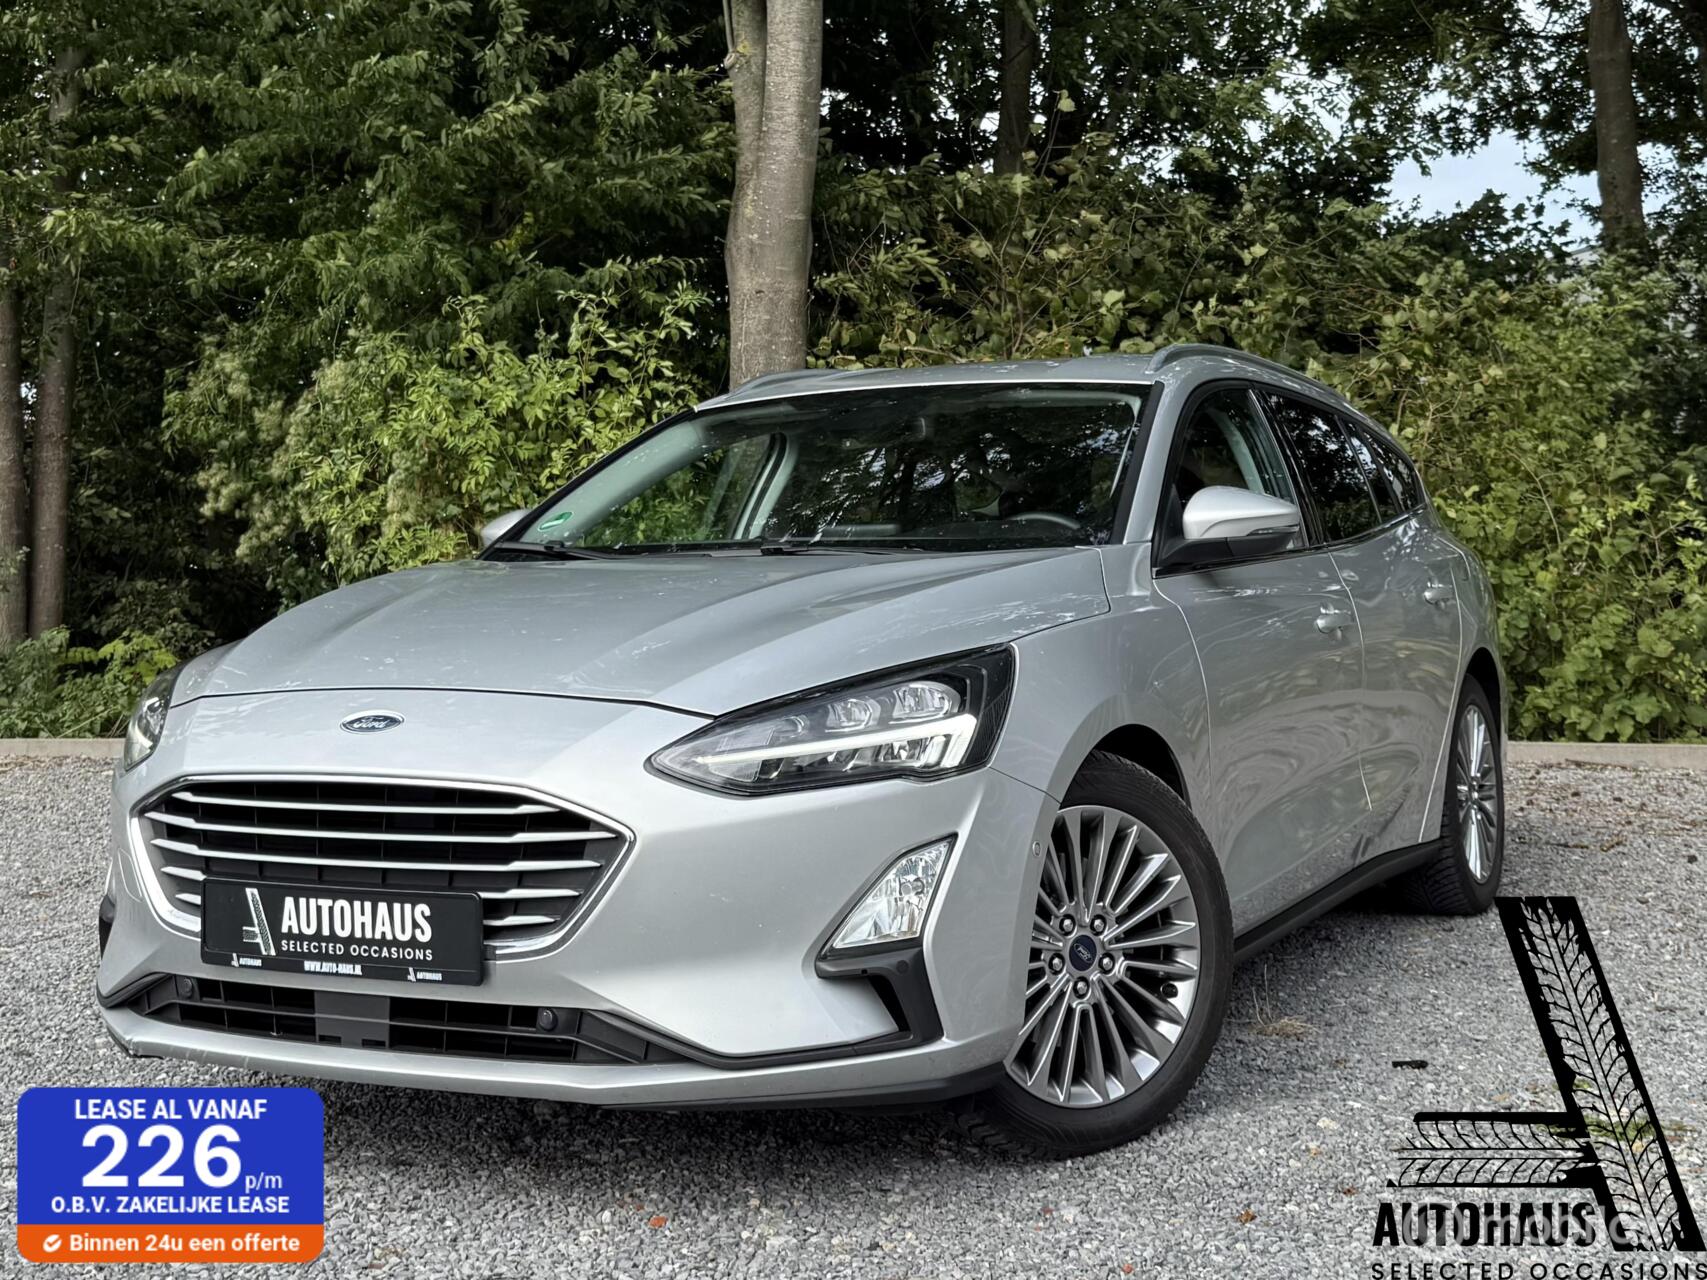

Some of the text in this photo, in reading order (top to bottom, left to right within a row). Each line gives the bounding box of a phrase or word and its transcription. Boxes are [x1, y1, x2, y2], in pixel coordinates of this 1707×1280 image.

[281, 896, 432, 942] AUTOHAUS
[281, 939, 433, 961] SELECTED OCCASIONS
